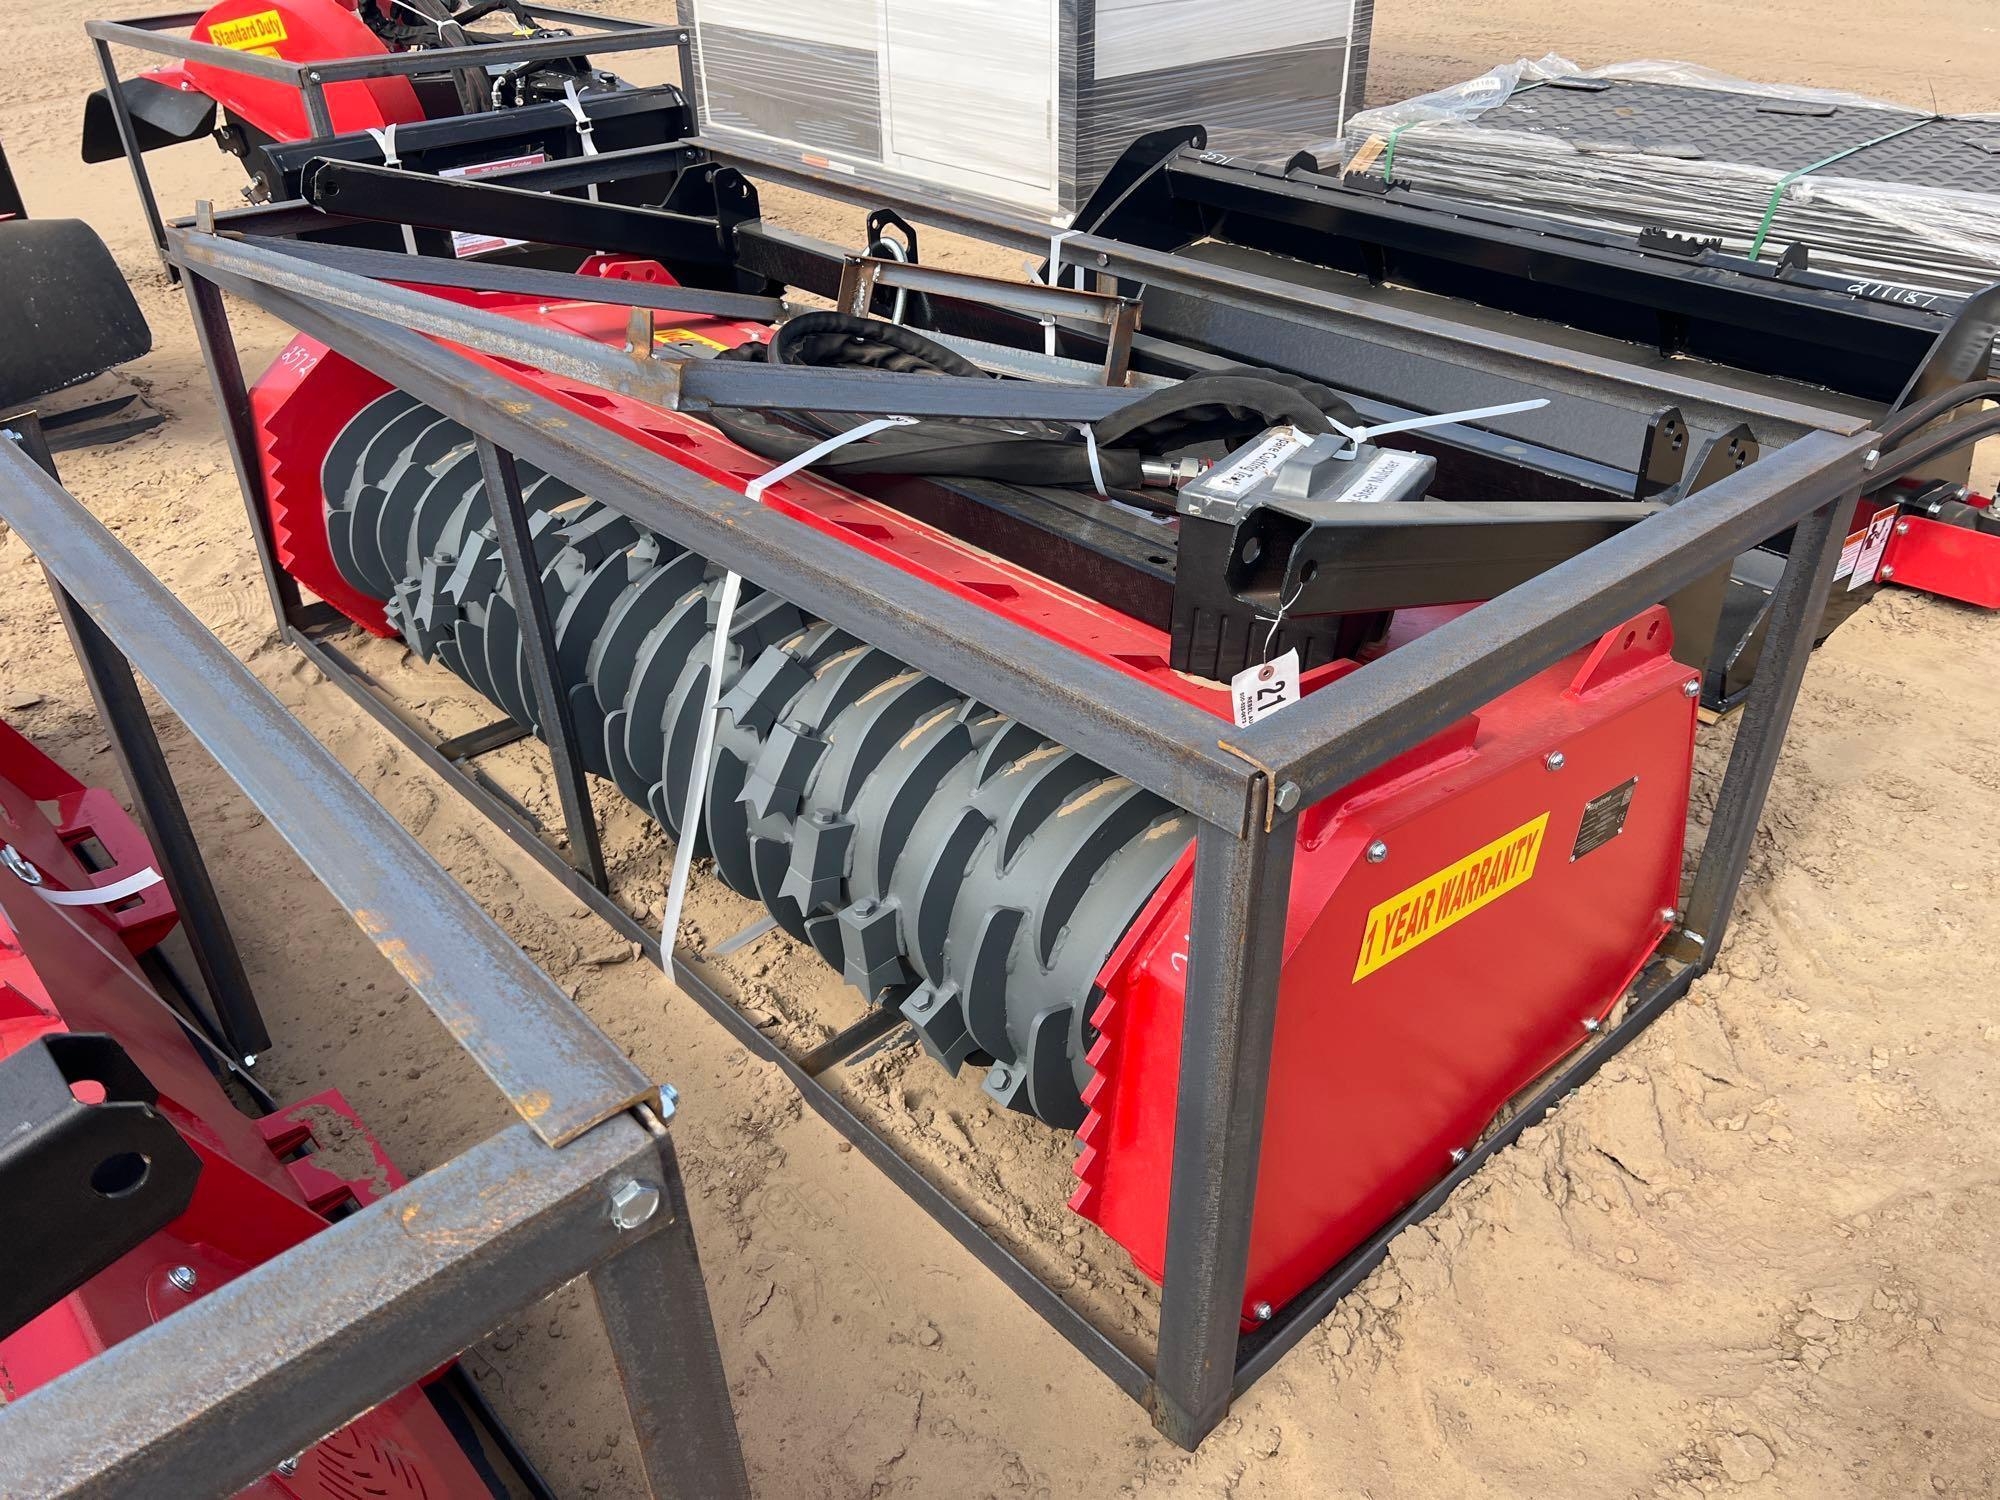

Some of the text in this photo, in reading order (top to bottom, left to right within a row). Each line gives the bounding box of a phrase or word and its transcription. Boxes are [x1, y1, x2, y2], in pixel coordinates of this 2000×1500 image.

[213, 16, 282, 46] Standard Duty
[1268, 438, 1290, 454] pare
[1240, 452, 1277, 472] Cutting
[1368, 460, 1400, 484] Mulcher
[1257, 680, 1287, 712] 21
[1364, 828, 1540, 966] 1 YEAR WARRANTY
